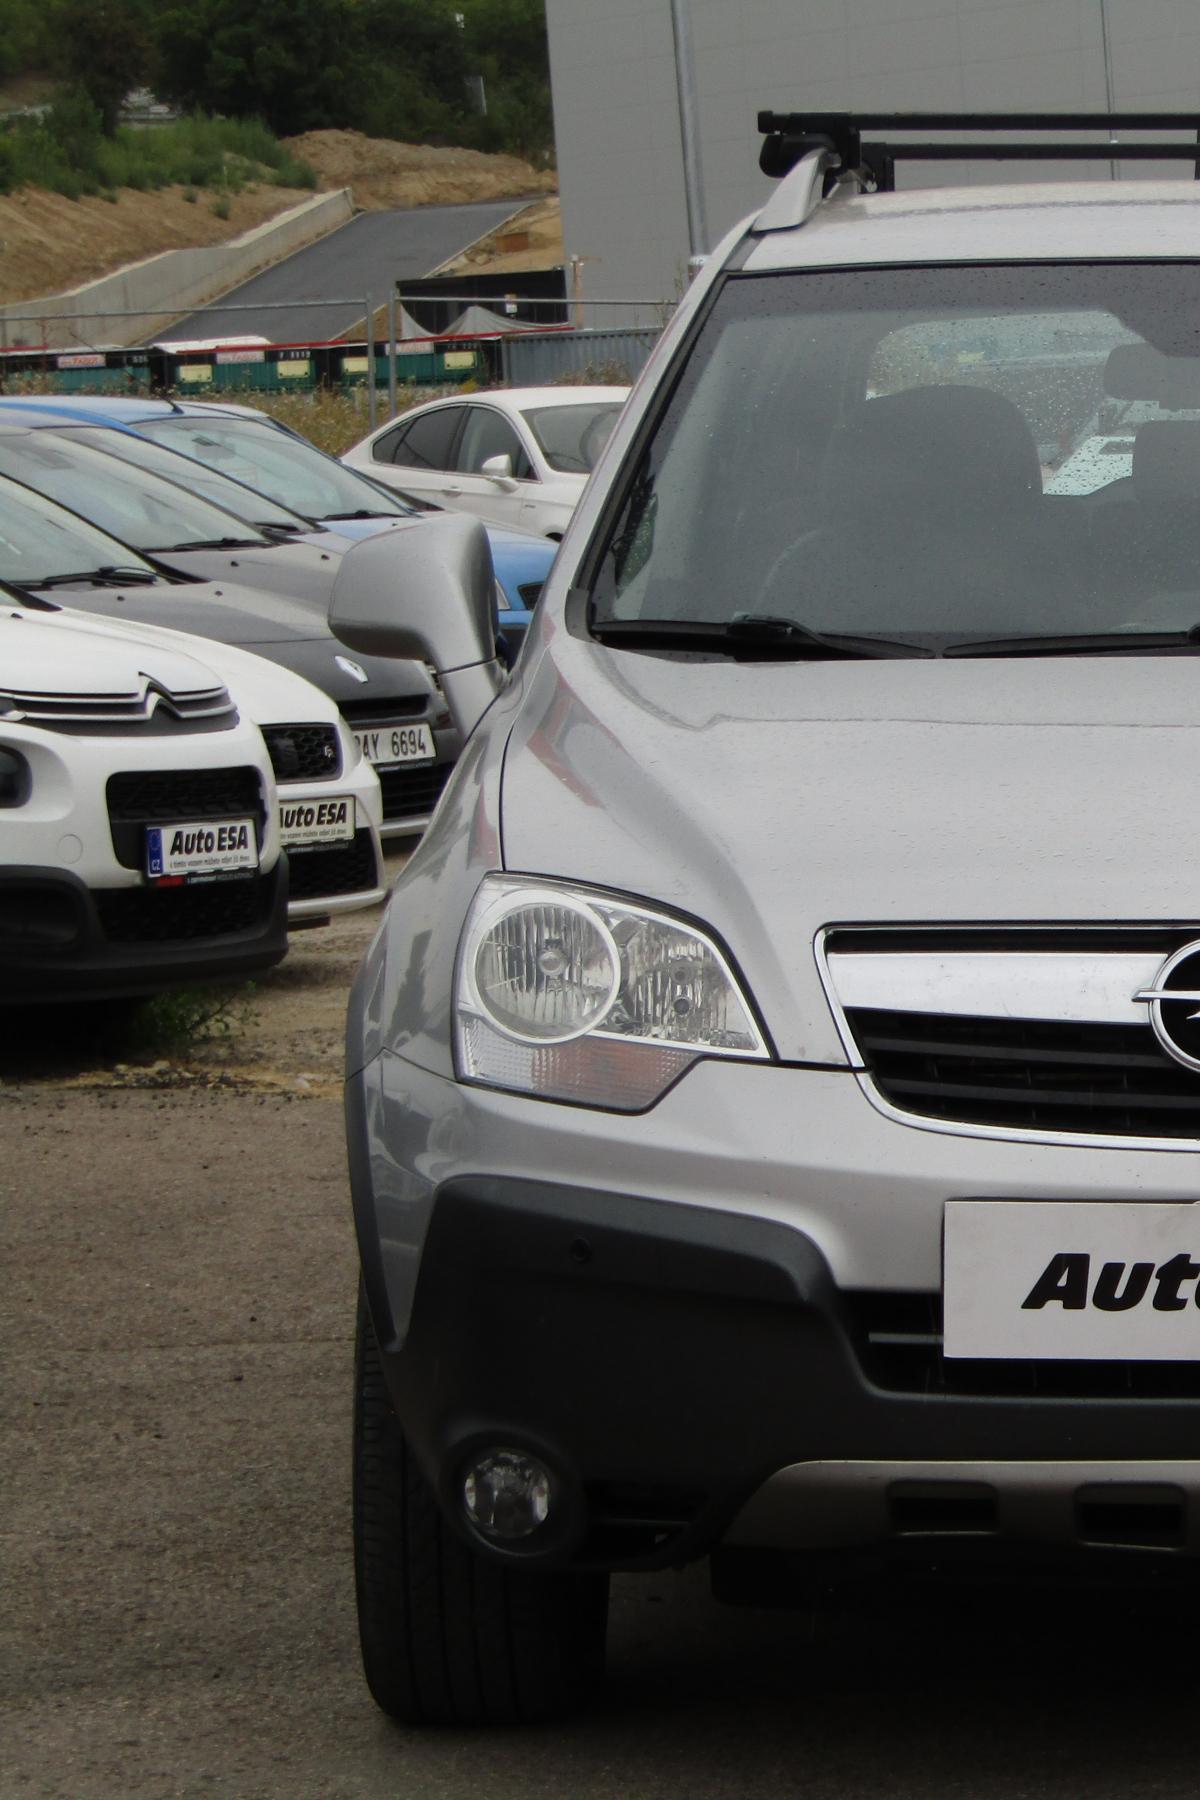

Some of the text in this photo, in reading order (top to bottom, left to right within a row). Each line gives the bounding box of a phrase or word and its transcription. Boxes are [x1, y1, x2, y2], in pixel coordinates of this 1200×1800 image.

[391, 729, 426, 757] 6694
[316, 802, 347, 826] ESA
[170, 825, 248, 856] Auto ESA
[151, 859, 161, 871] CZ
